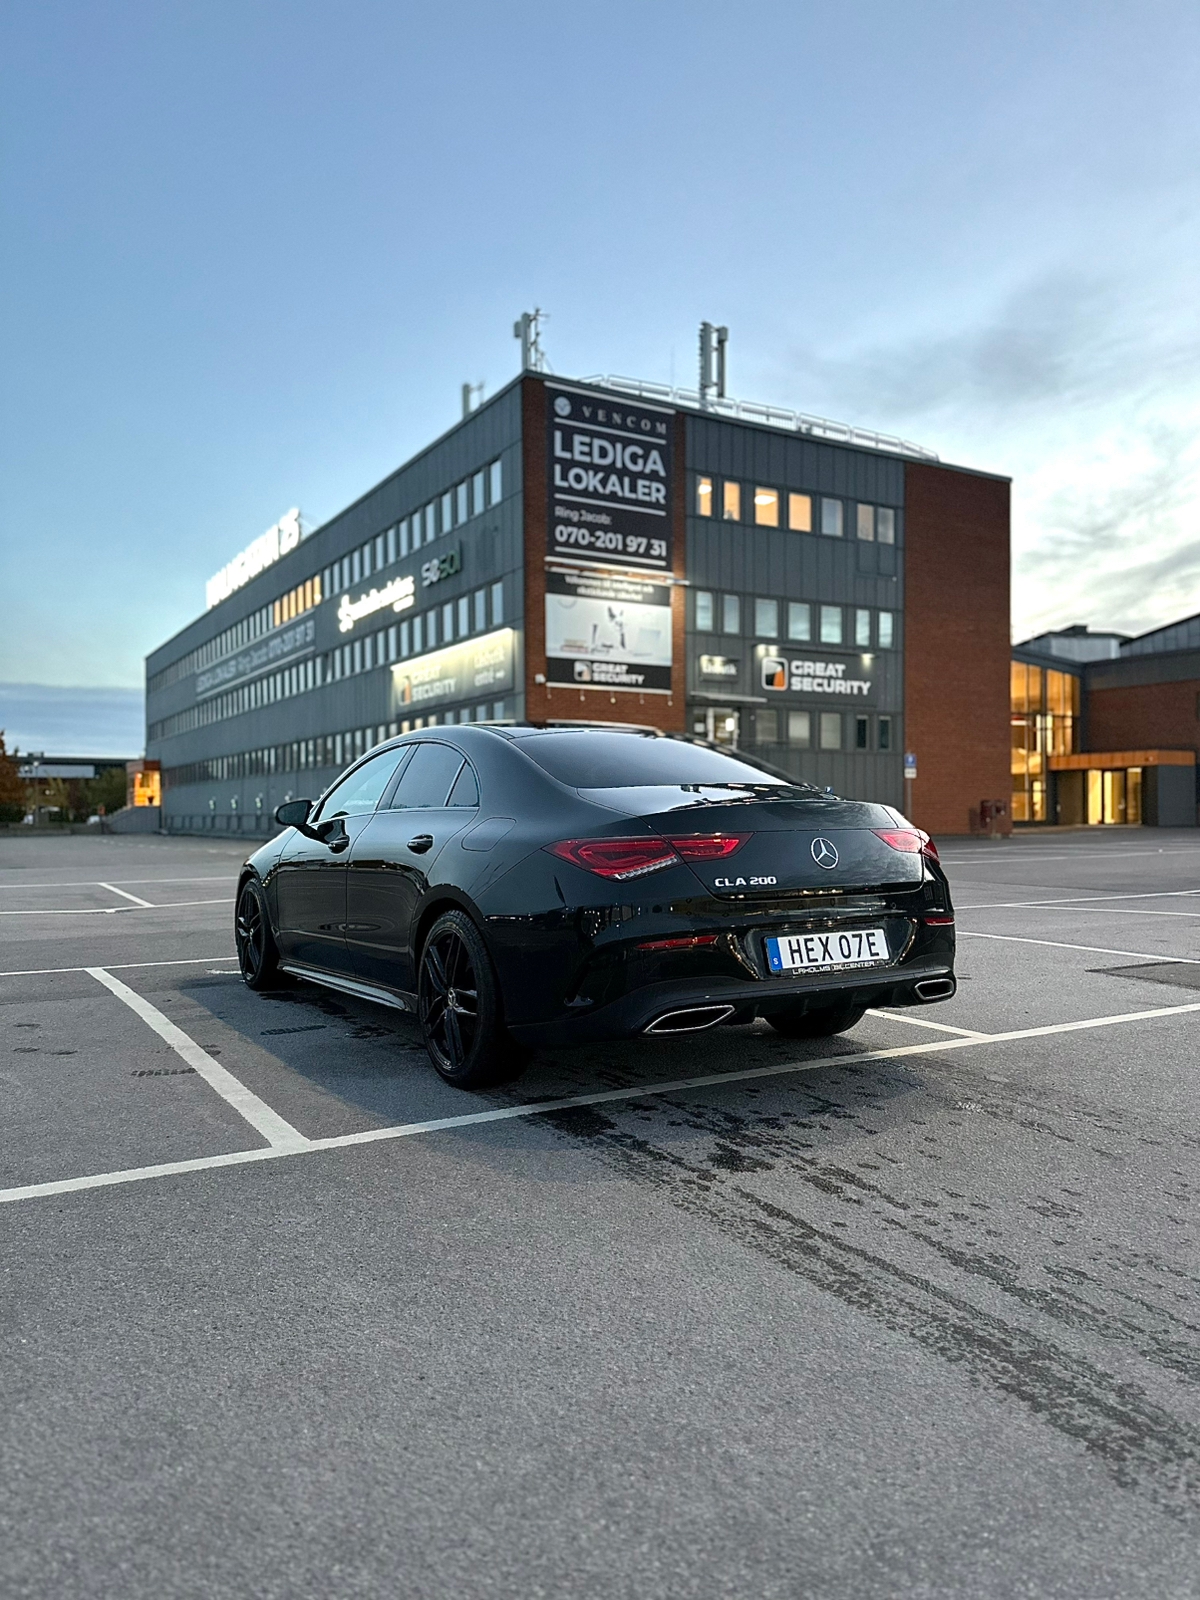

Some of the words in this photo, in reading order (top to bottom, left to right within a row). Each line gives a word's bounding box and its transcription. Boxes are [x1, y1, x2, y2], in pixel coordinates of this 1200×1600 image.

[582, 405, 667, 435] VENCOM
[553, 429, 667, 477] LEDIGA
[553, 463, 667, 505] LOKALER
[554, 505, 580, 523] Ring
[554, 524, 623, 551] 070-201
[625, 535, 648, 554] 97
[649, 539, 667, 557] 31
[592, 662, 629, 675] GREAT
[592, 671, 645, 685] SECURITY
[791, 659, 846, 678] GREAT
[412, 677, 457, 701] SECURITY
[791, 676, 871, 696] SECURITY
[714, 877, 747, 888] CLA
[749, 876, 777, 886] 200
[788, 936, 834, 965] HEX
[839, 932, 880, 960] 07E
[773, 957, 779, 965] S
